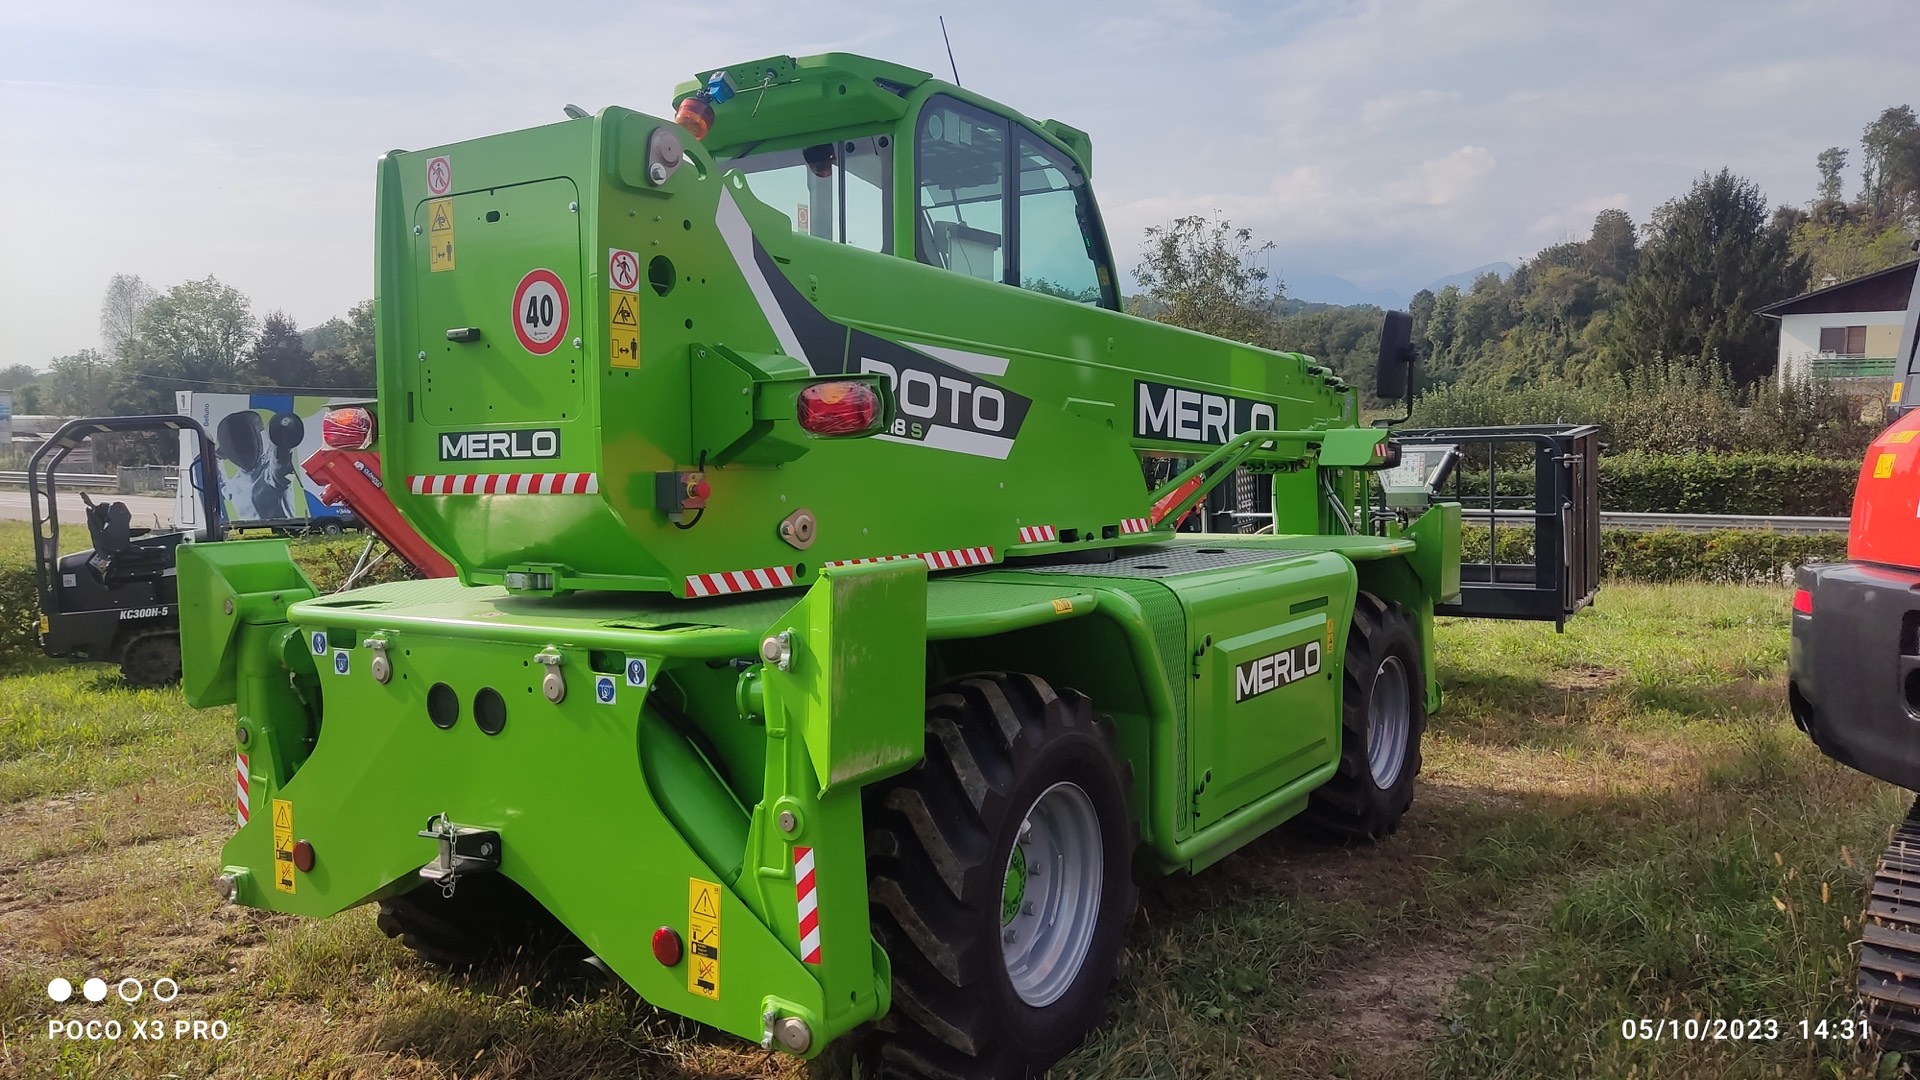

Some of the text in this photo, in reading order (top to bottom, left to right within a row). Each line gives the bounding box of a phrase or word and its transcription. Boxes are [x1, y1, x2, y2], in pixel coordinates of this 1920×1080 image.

[526, 294, 554, 328] 40
[1139, 383, 1275, 448] MERLO
[442, 431, 557, 459] MERLO
[120, 606, 169, 620] KC300H-5
[1236, 641, 1321, 701] MERLO
